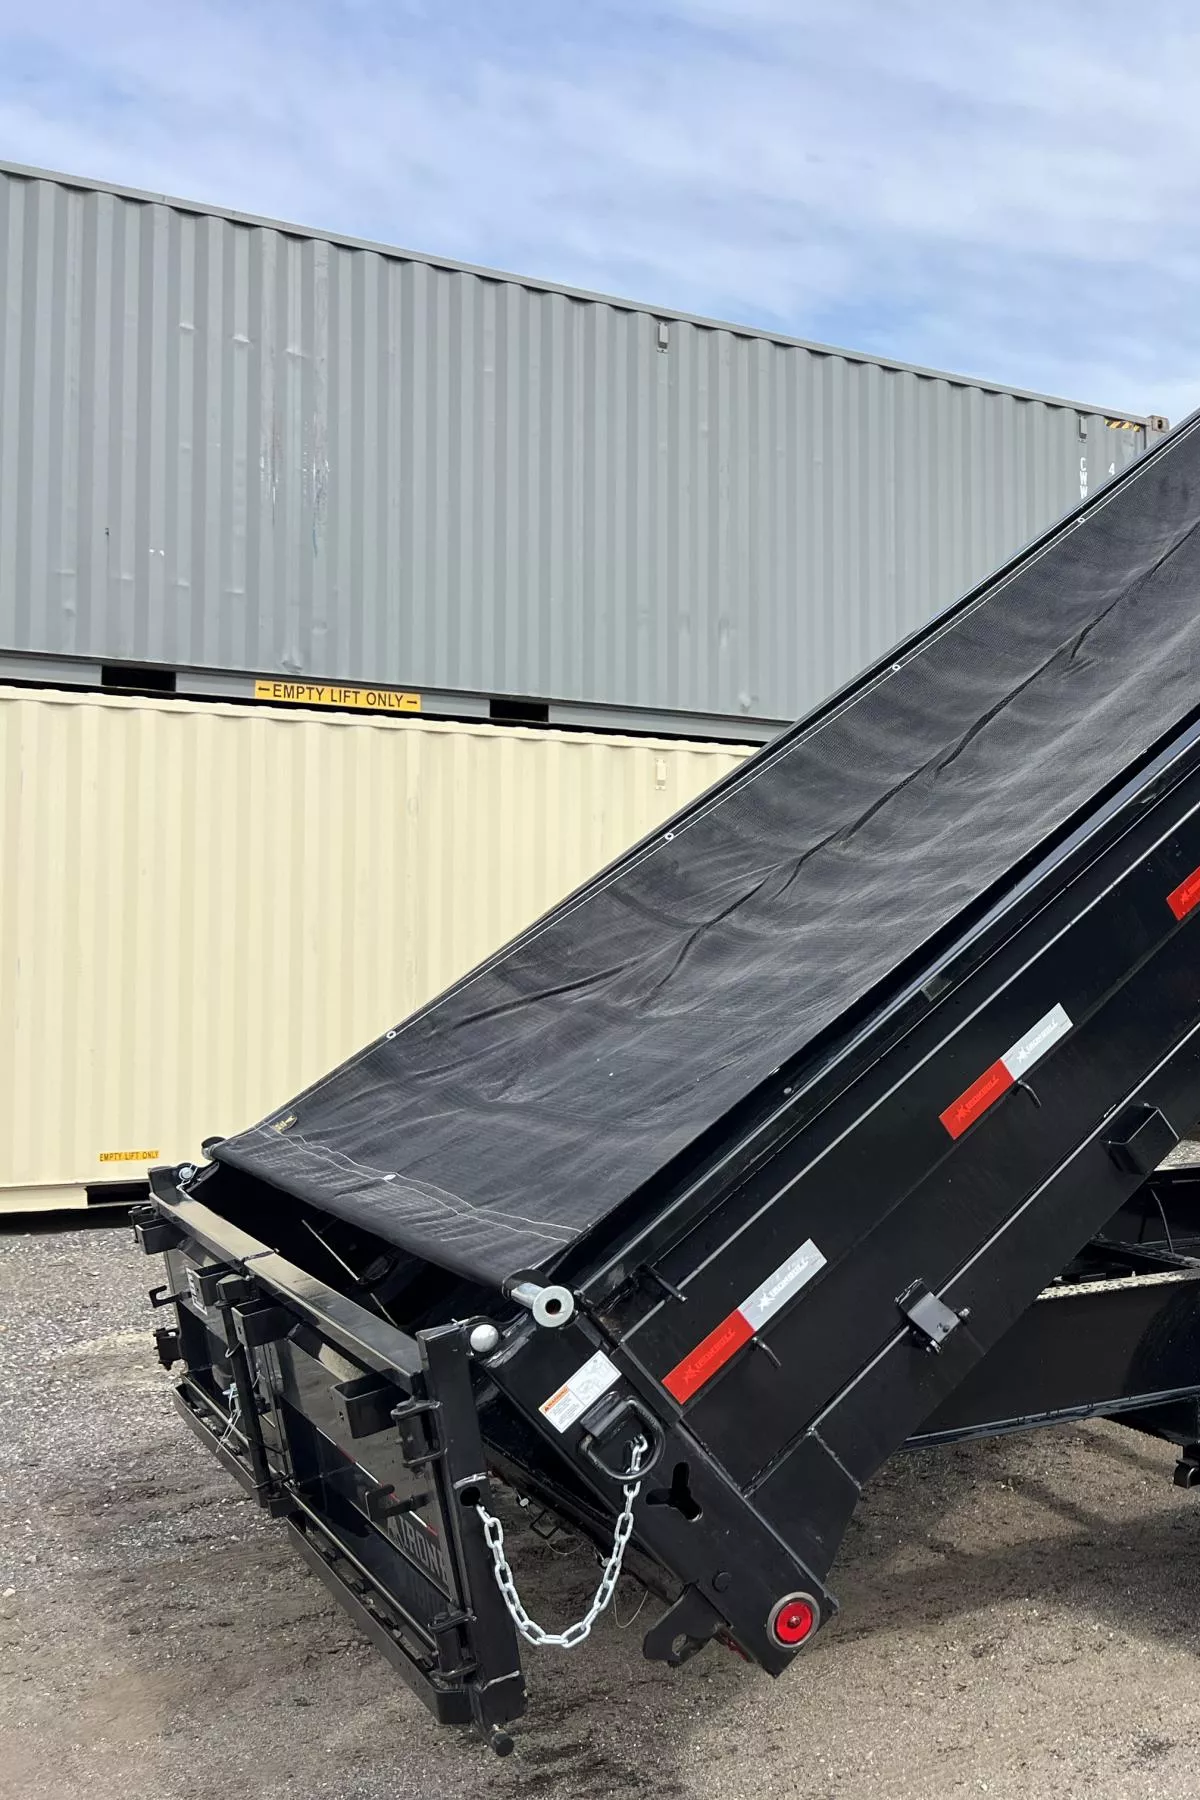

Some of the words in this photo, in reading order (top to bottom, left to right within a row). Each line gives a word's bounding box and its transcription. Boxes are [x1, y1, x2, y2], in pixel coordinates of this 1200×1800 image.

[273, 683, 325, 701] EMPTY
[330, 689, 360, 704] LIFT
[366, 692, 403, 707] ONLY
[100, 1153, 121, 1161] EMPTY
[125, 1152, 139, 1160] LIFT
[142, 1151, 159, 1159] ONLY
